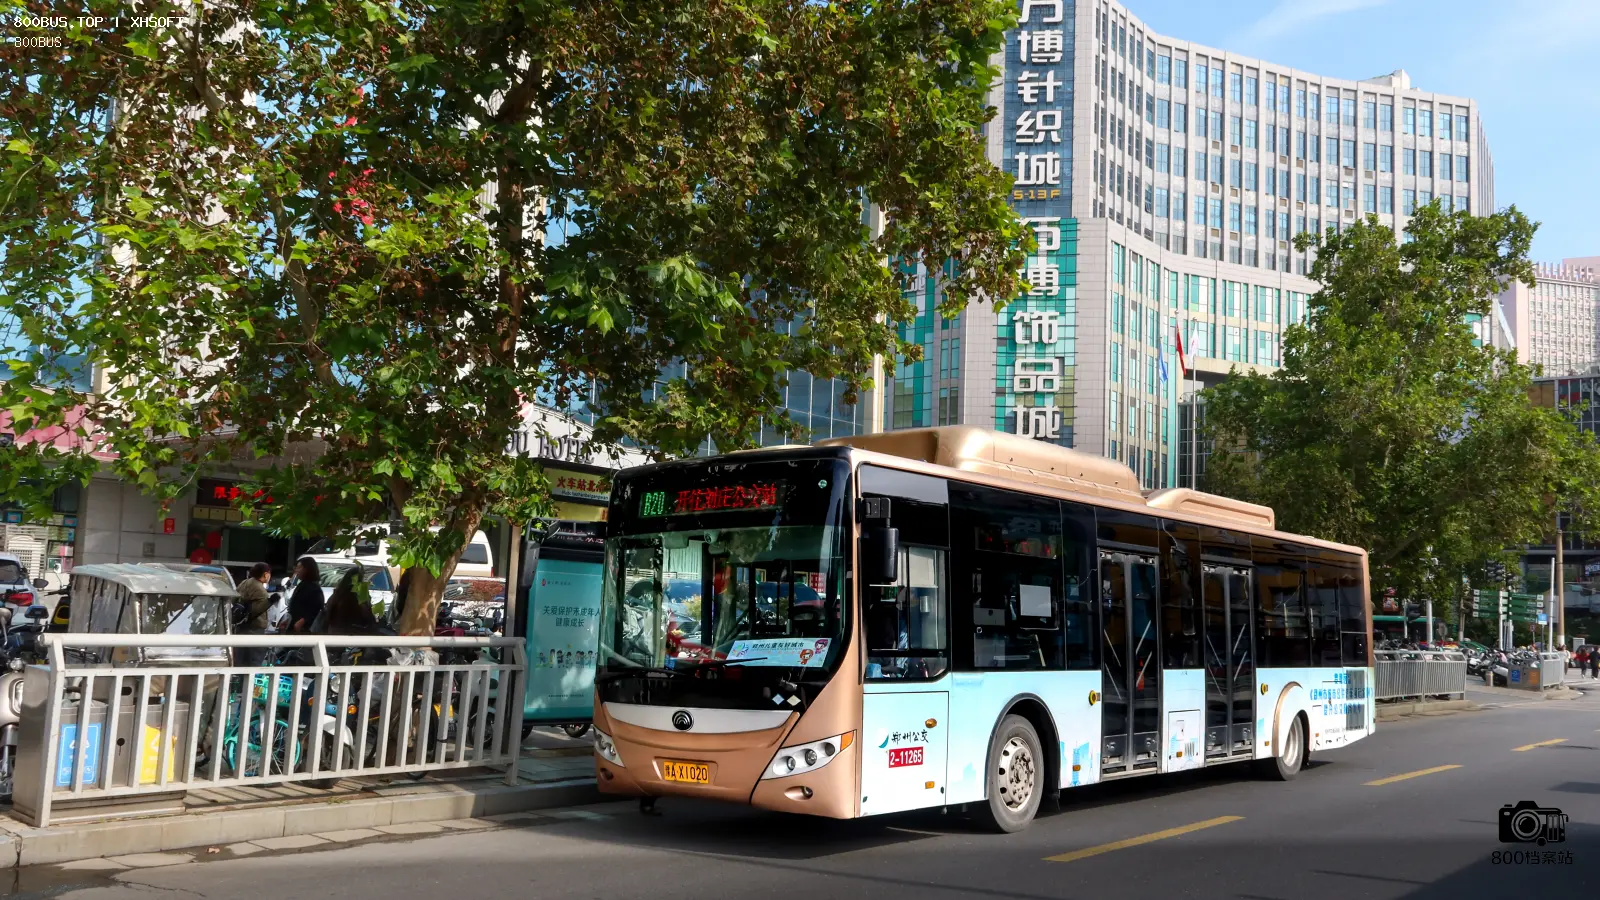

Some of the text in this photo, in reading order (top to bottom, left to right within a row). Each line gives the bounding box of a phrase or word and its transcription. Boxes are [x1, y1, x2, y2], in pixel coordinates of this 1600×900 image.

[543, 605, 600, 617] 关爱保护未成年人
[555, 617, 585, 628] 健康成长
[891, 729, 929, 745] 郑州公交
[890, 749, 923, 766] 2-11265
